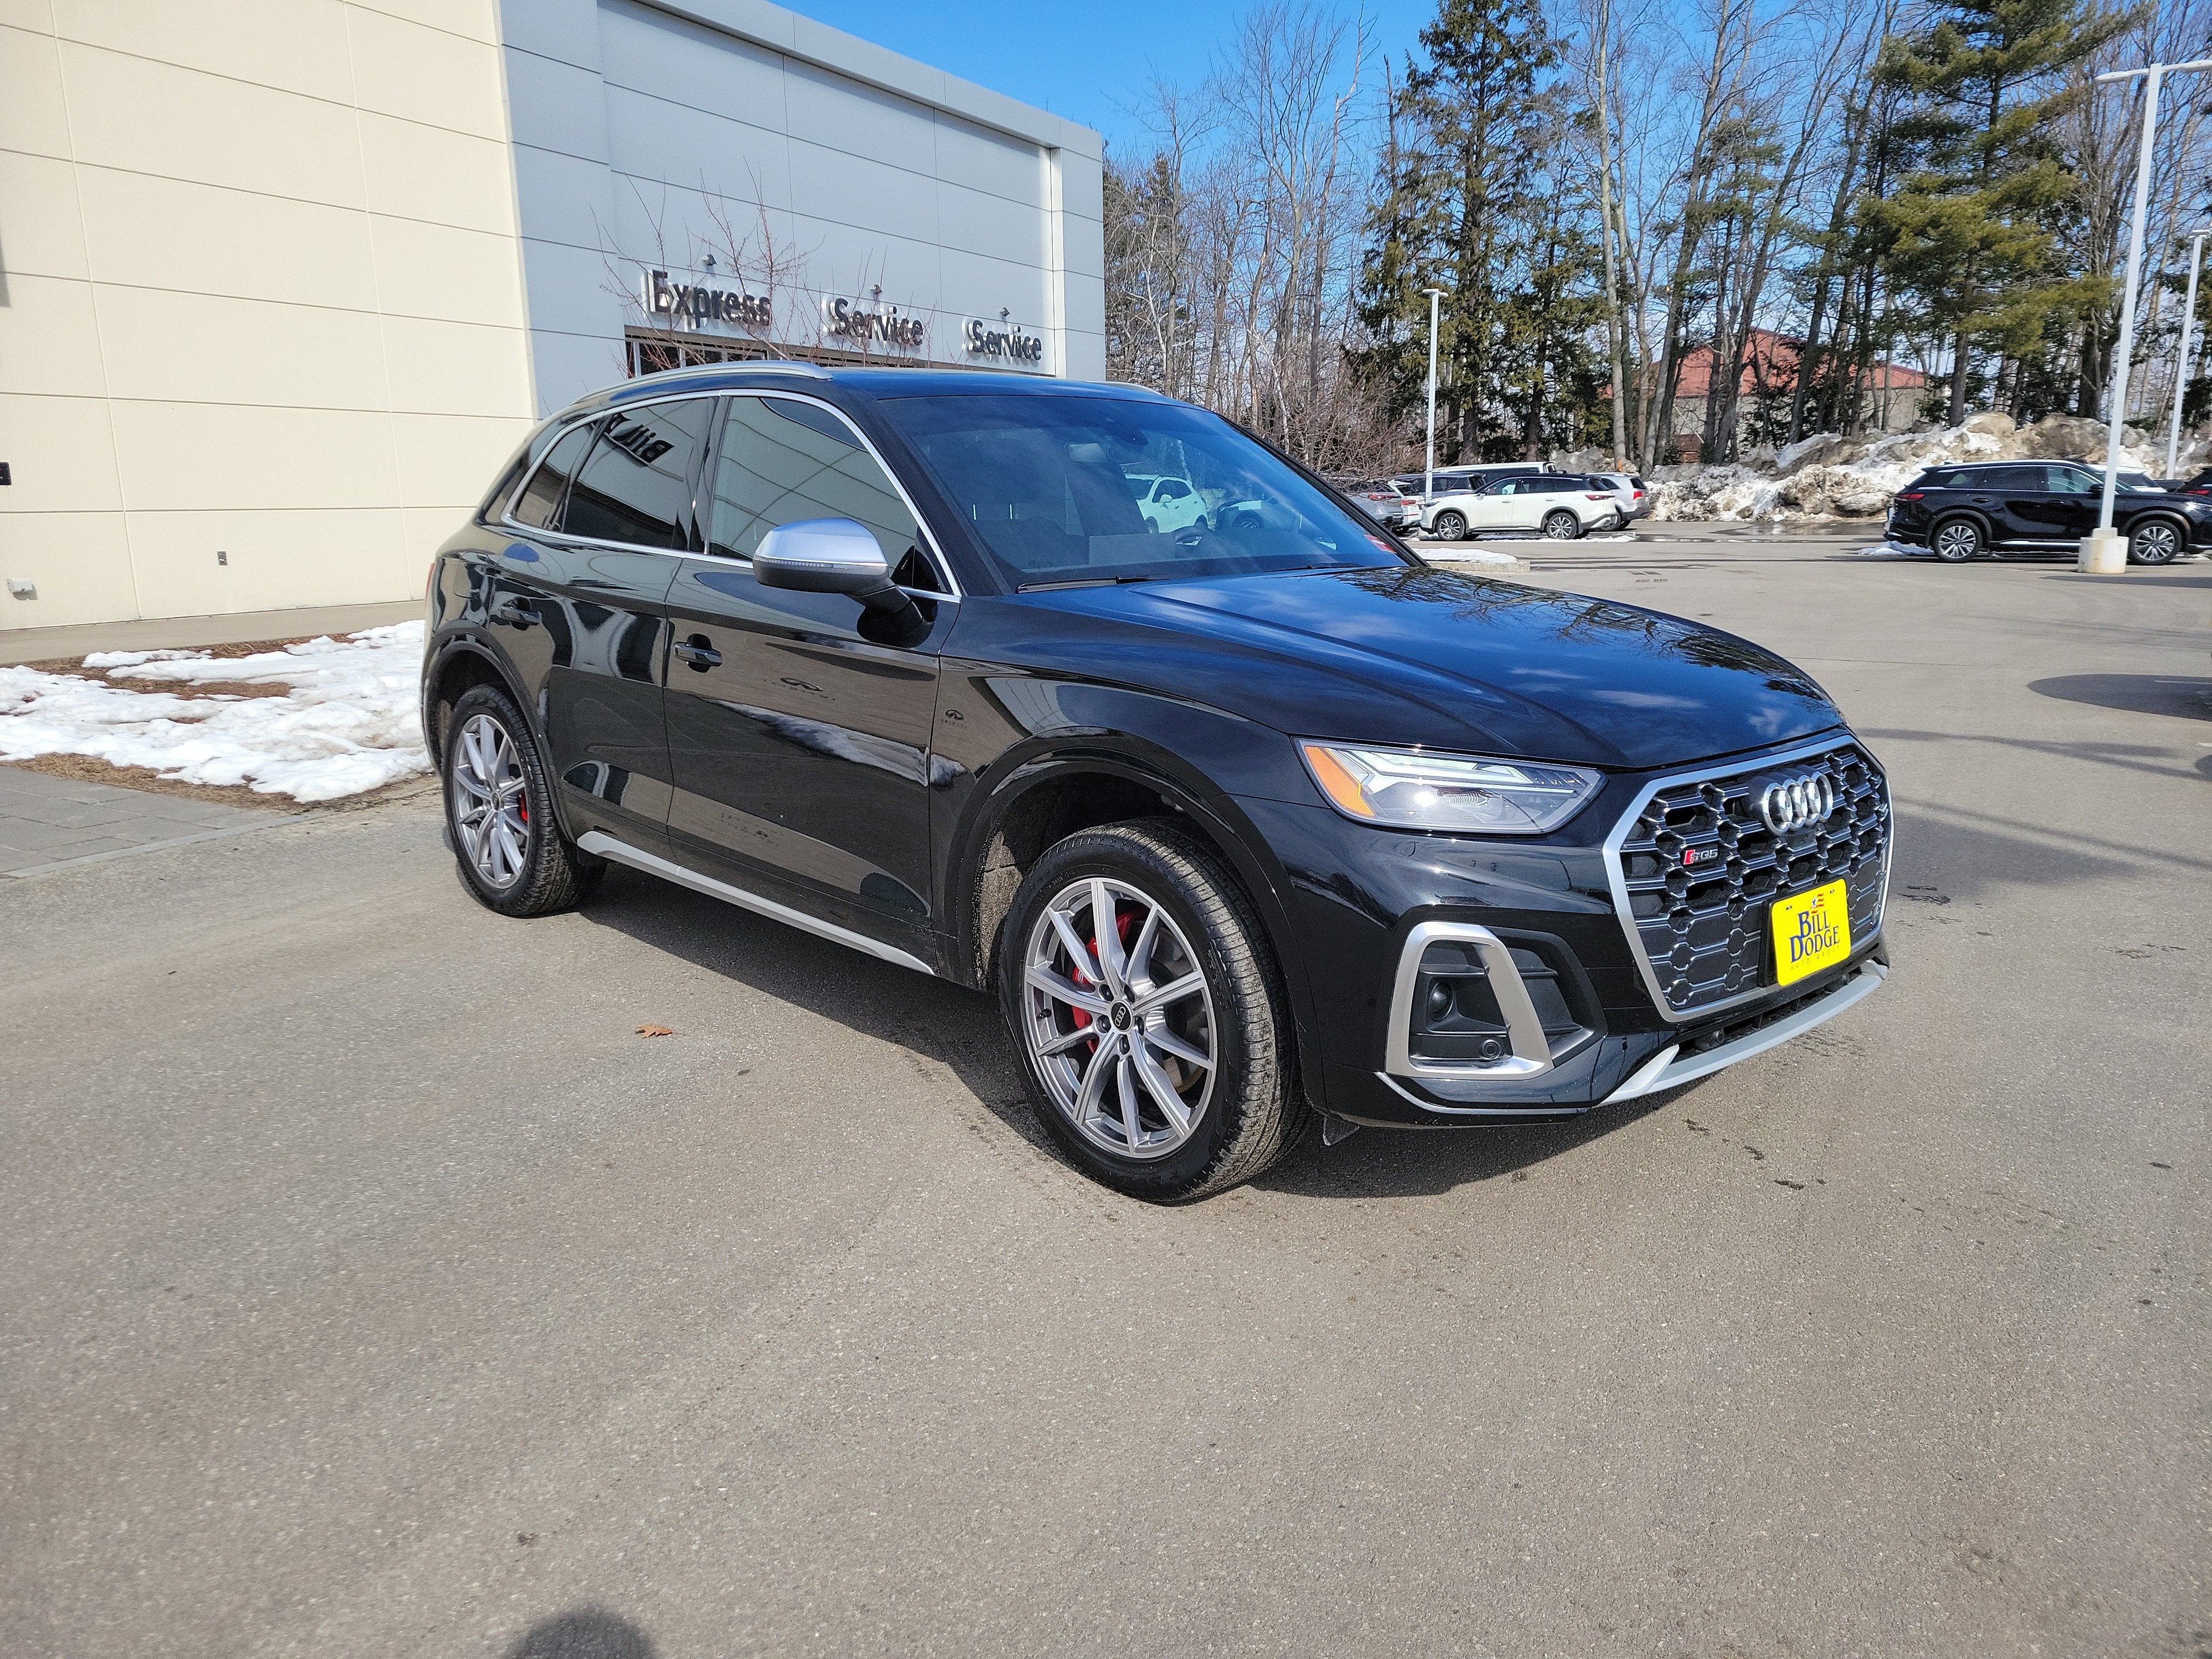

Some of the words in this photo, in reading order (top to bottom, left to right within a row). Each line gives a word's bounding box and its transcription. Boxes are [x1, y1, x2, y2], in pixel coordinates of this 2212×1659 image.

[647, 269, 772, 329] Express
[830, 297, 923, 346] Service
[969, 319, 1042, 360] Service
